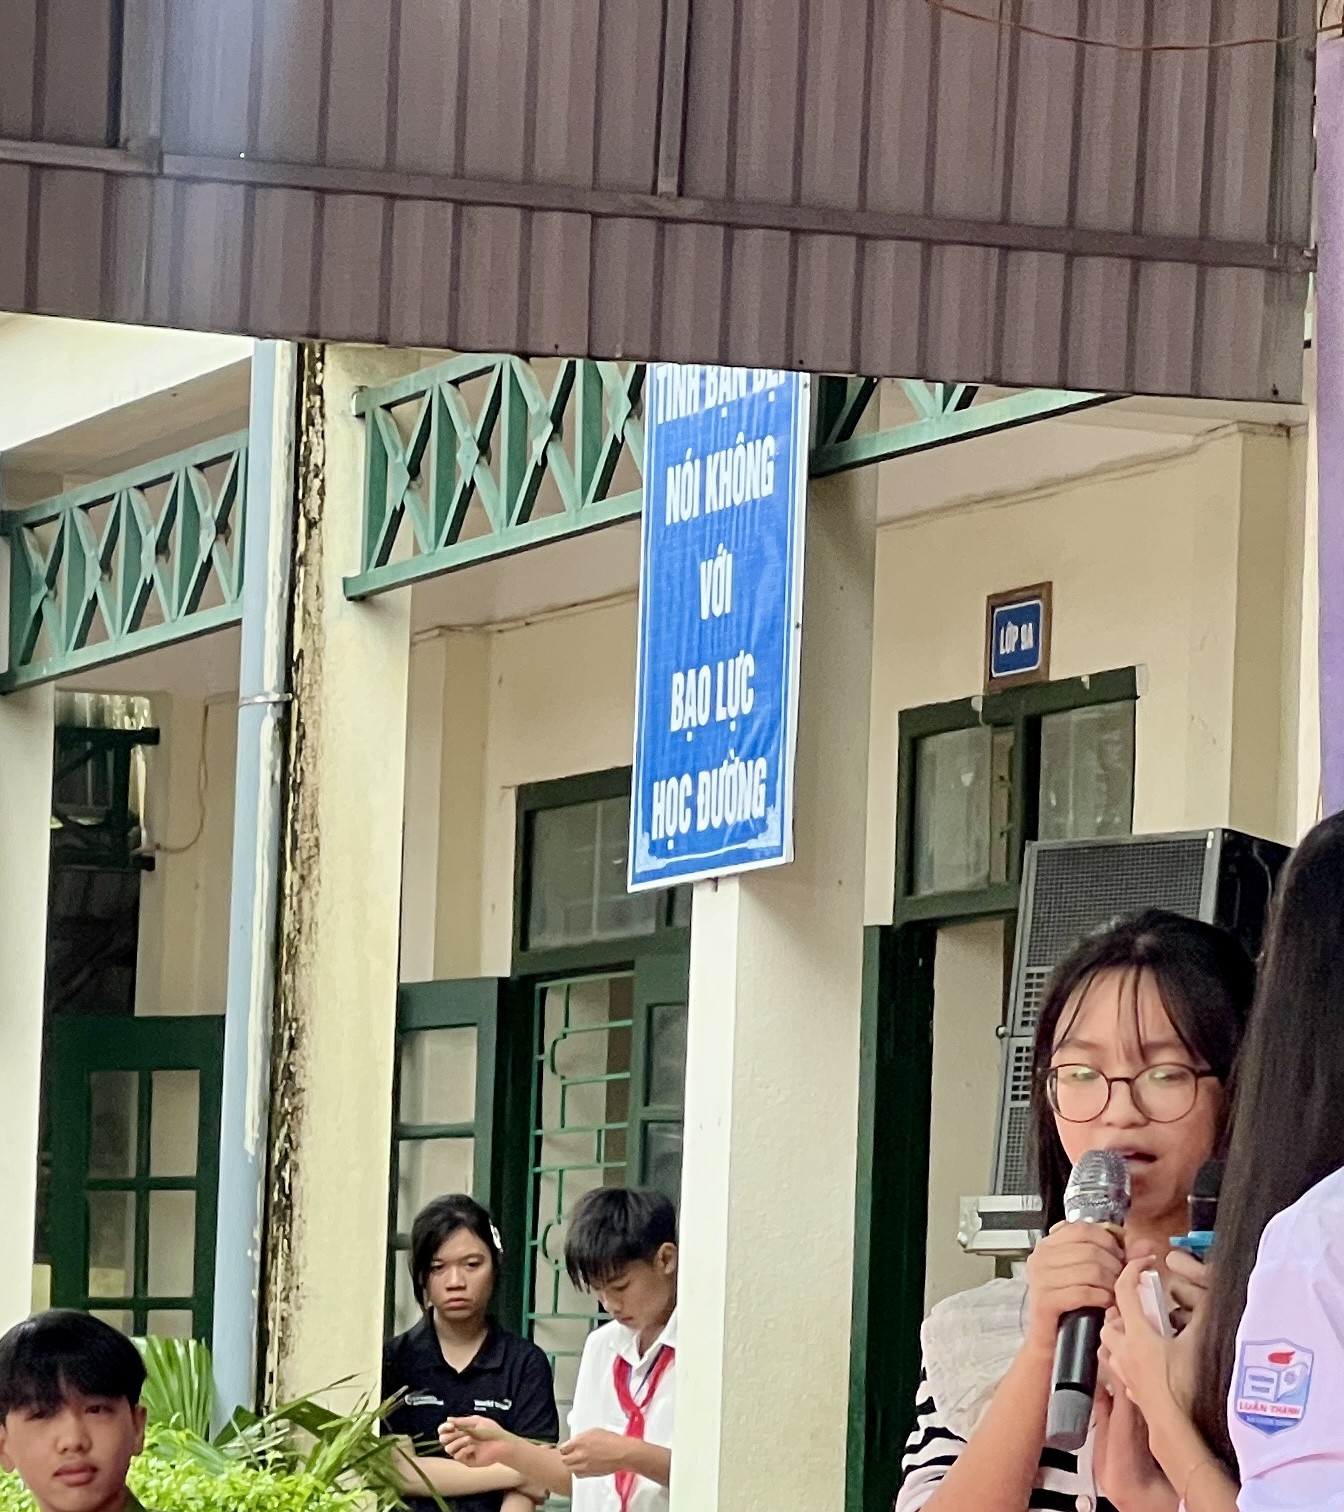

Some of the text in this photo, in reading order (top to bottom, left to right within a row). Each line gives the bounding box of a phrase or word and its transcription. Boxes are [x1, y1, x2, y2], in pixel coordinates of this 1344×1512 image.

[665, 431, 775, 526] NÓI KHÔNG
[700, 542, 733, 620] VỚI
[670, 649, 755, 742] BẠO LỰC
[651, 748, 768, 850] HỌC ĐƯỜNG
